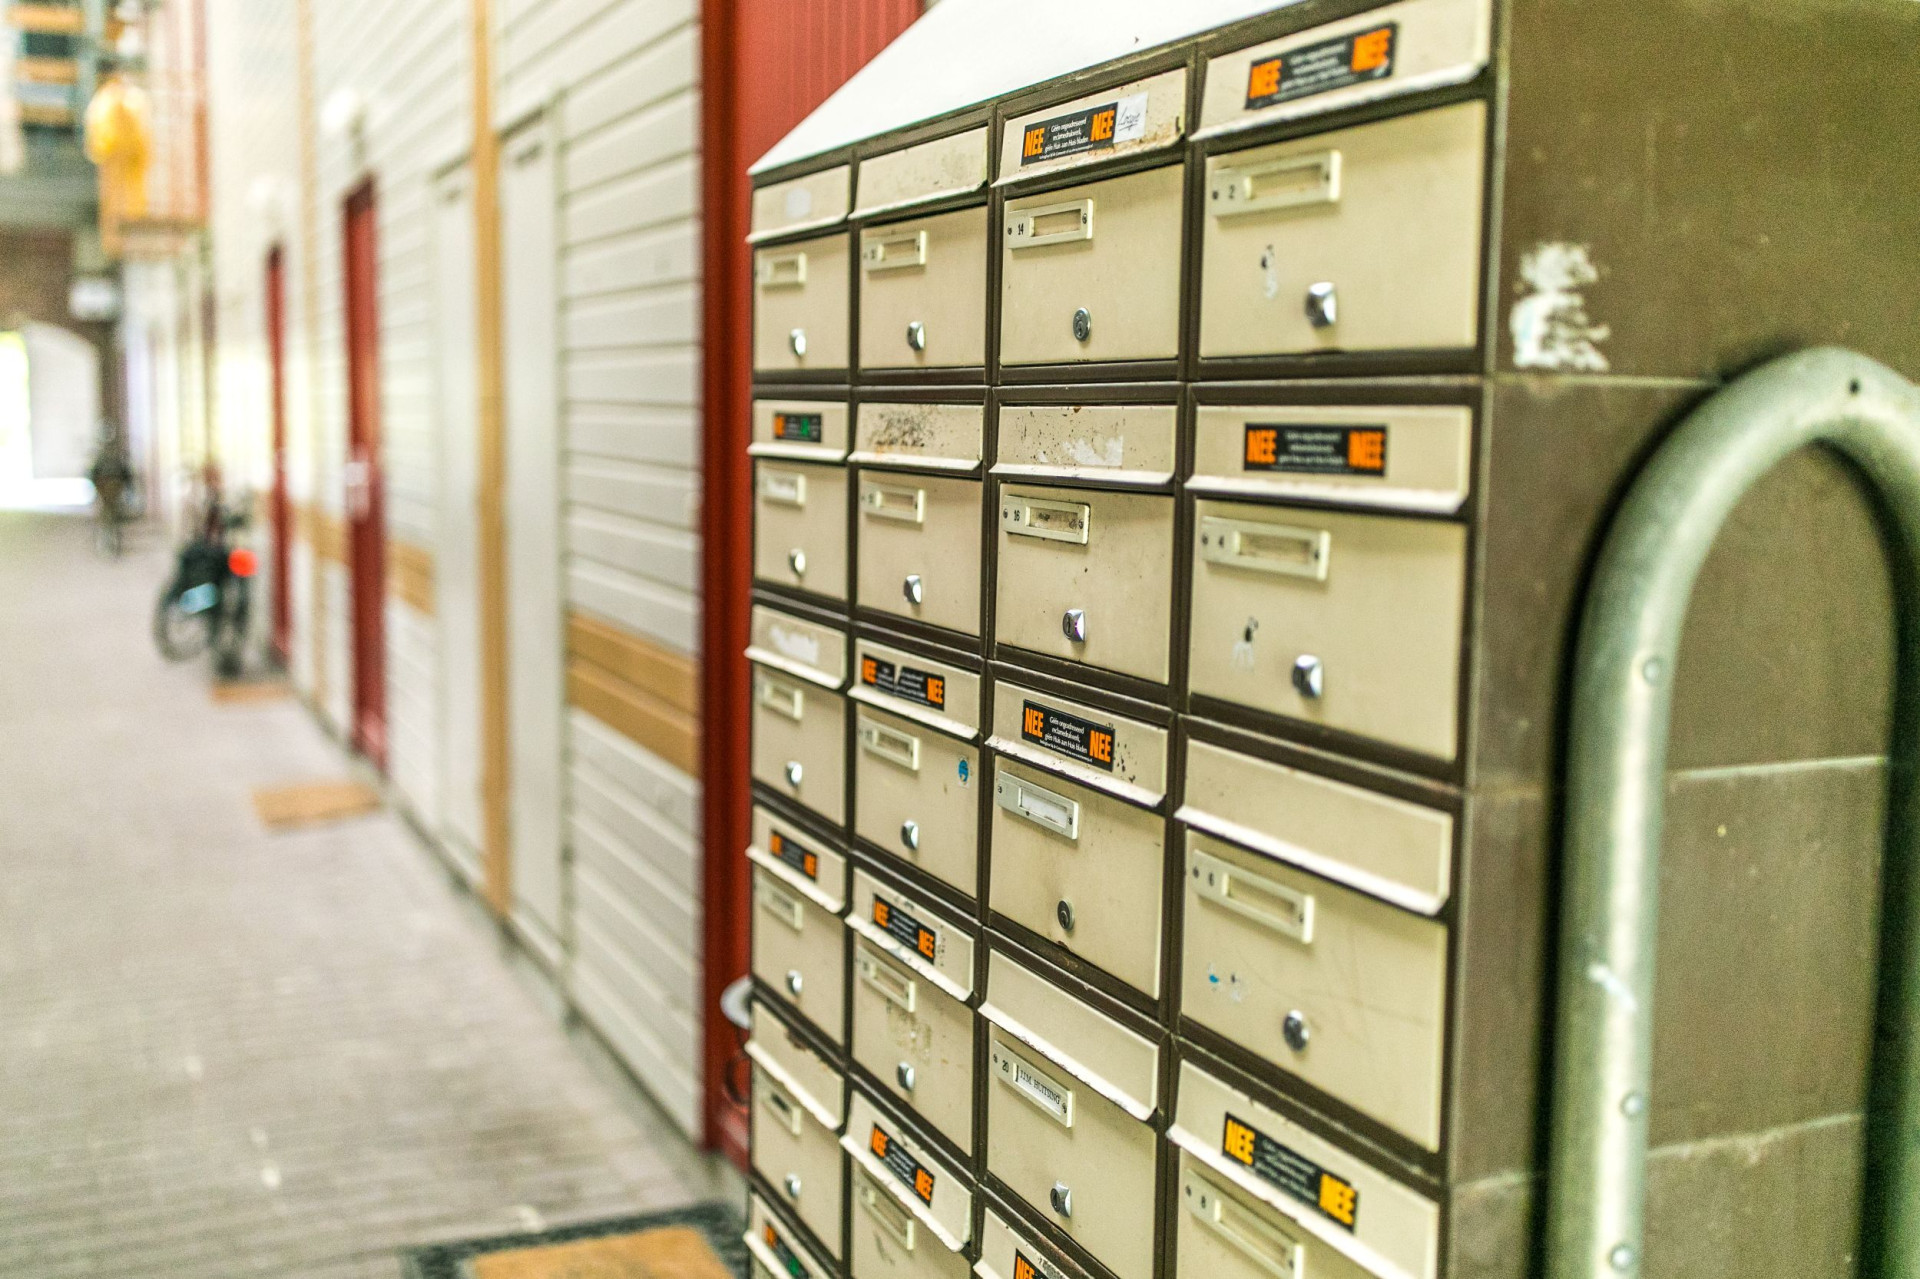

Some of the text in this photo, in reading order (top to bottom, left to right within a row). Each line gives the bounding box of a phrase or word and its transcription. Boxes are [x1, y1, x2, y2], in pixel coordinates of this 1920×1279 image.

[1352, 28, 1391, 73] NEE
[1249, 59, 1282, 99] NEE
[1023, 127, 1046, 158] NEE
[1090, 110, 1116, 142] NEE
[1228, 184, 1236, 200] 2
[1017, 222, 1025, 236] 14
[1246, 429, 1277, 464] NEE
[1348, 430, 1385, 470] NEE
[927, 676, 944, 705] NEE
[1024, 707, 1044, 738] NEE
[1088, 729, 1112, 763] NEE
[918, 928, 935, 959] NEE
[1224, 1118, 1257, 1167] NEE
[915, 1168, 934, 1202] NEE
[1318, 1173, 1357, 1226] NEE
